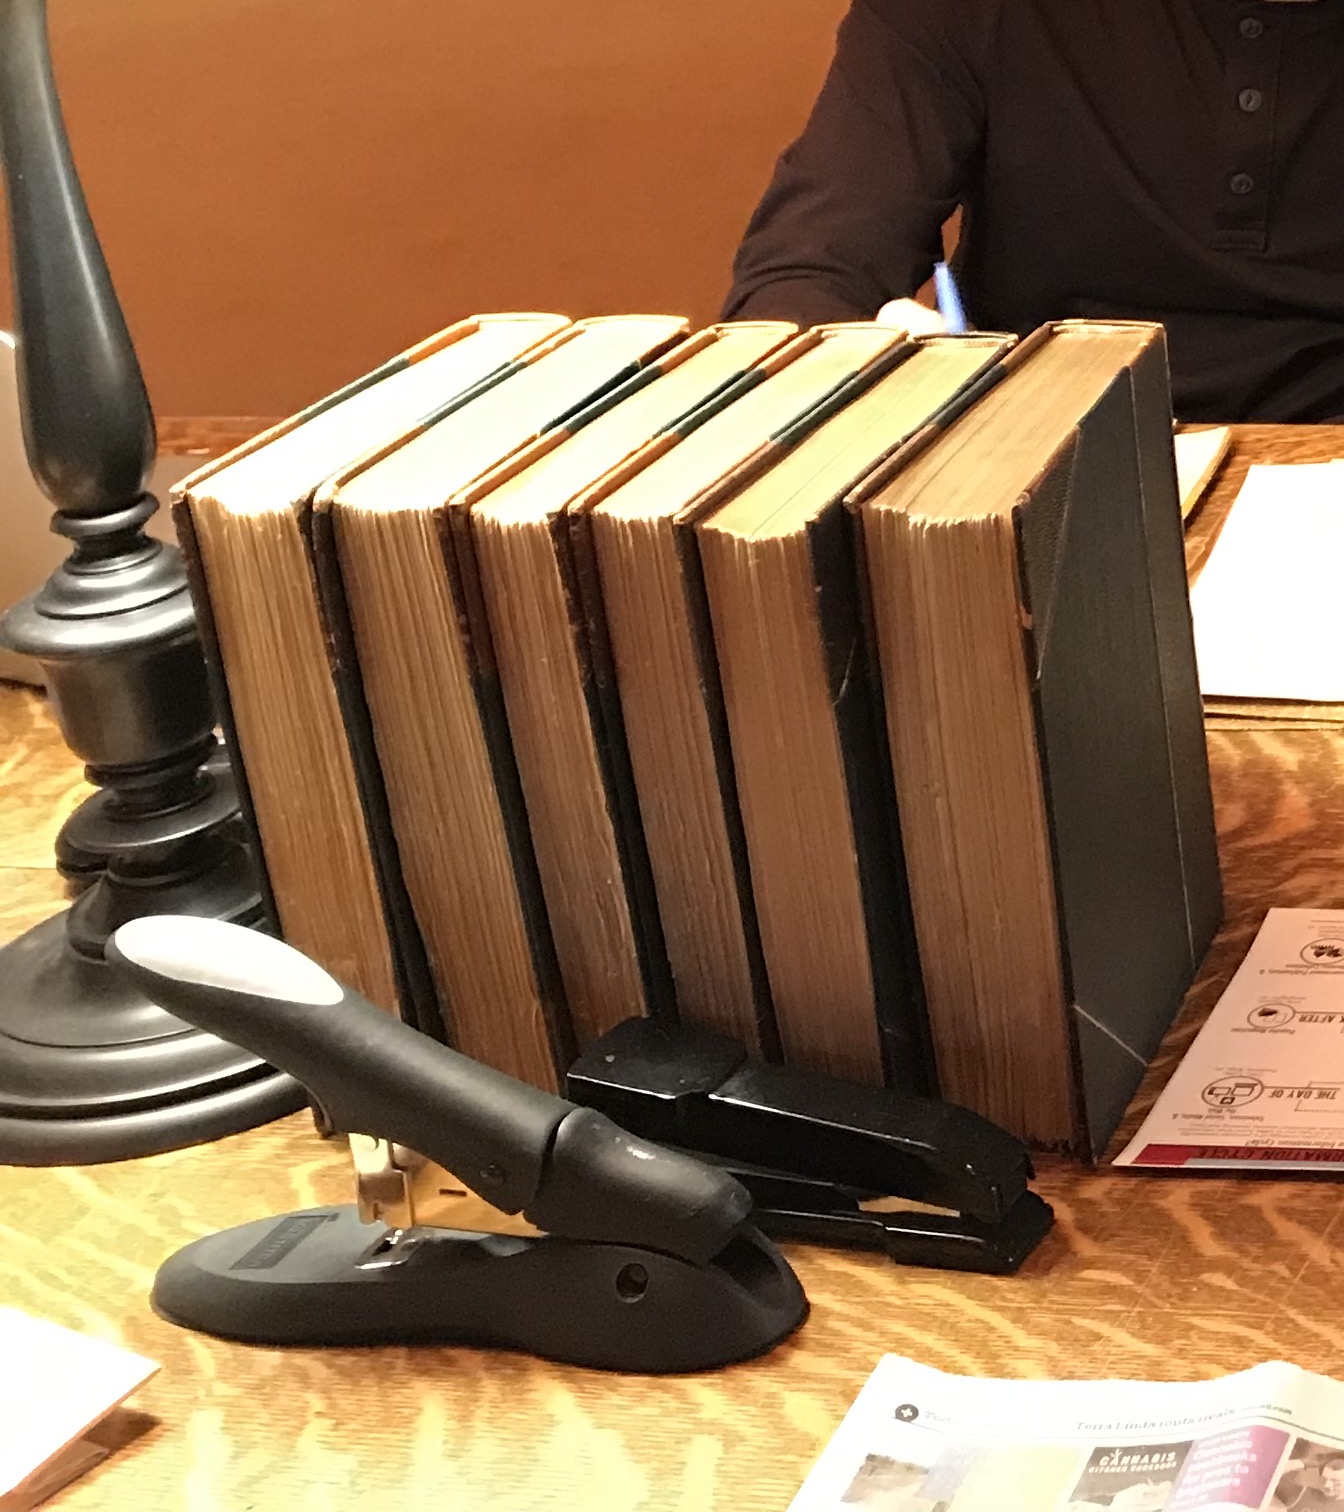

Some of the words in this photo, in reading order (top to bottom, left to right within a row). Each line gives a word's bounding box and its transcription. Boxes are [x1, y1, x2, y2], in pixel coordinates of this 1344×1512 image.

[1297, 1015, 1336, 1024] AFTER
[1266, 1090, 1285, 1099] OF
[1289, 1090, 1314, 1099] DAY
[1315, 1091, 1338, 1100] THE
[1077, 1421, 1115, 1431] Terra
[1117, 1420, 1156, 1430] Linda
[1098, 1450, 1176, 1468] CANNABIS
